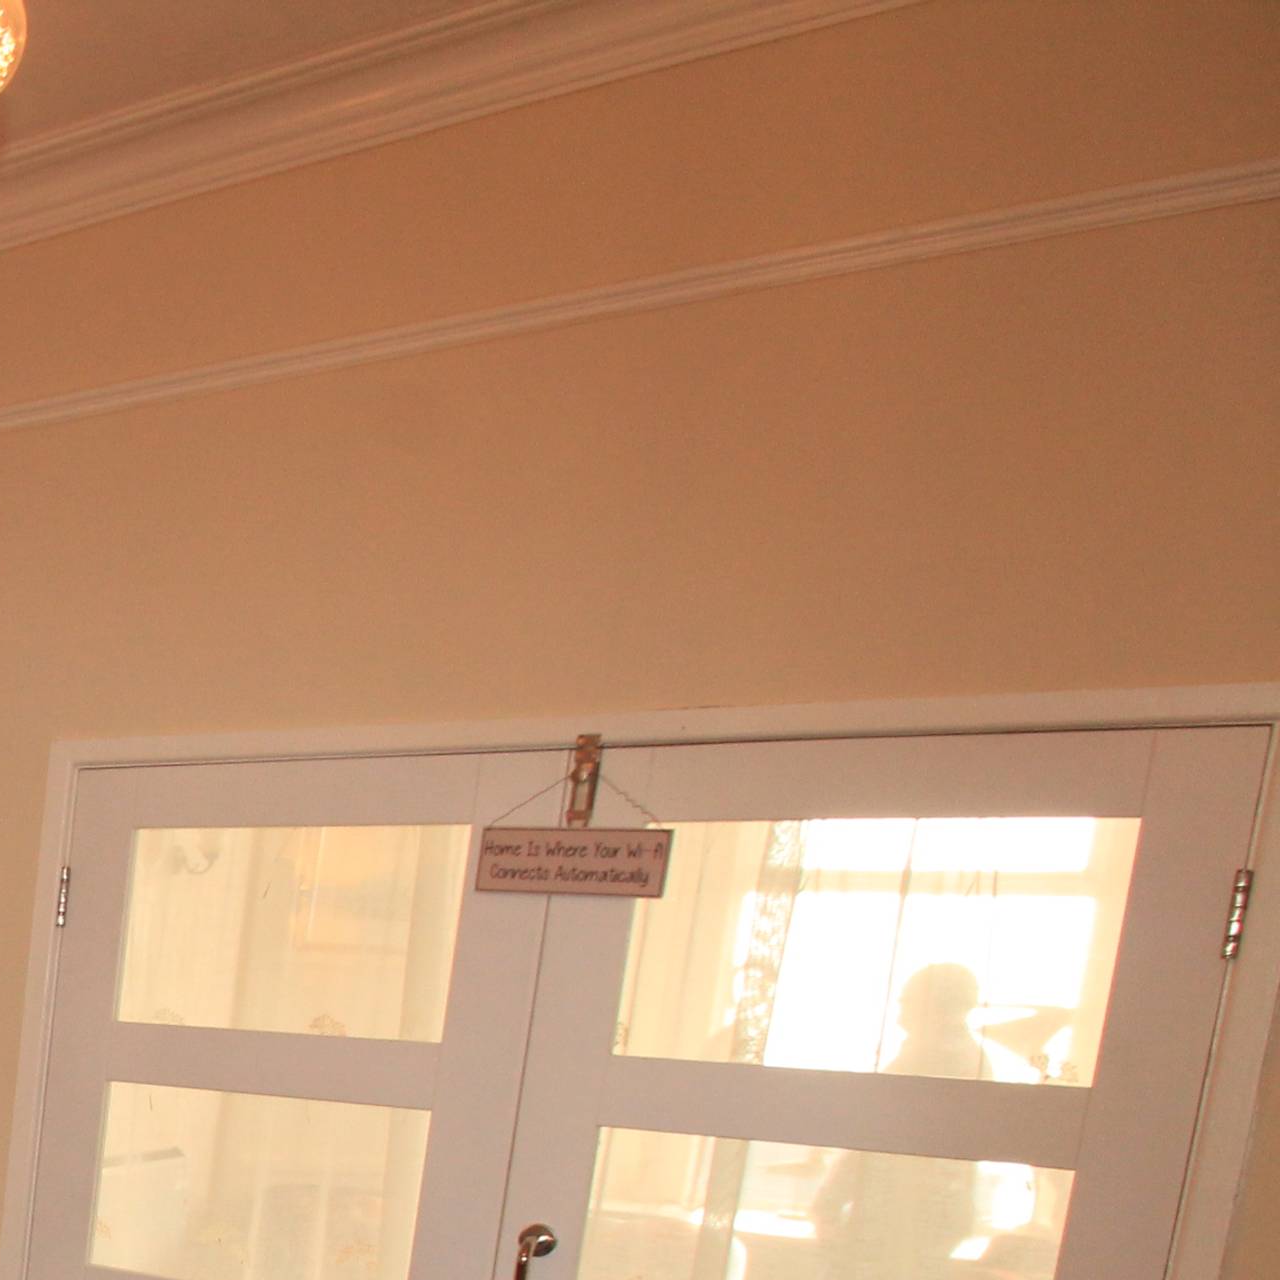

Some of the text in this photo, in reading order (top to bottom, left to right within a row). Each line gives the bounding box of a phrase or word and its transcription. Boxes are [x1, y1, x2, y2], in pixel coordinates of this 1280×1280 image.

[484, 840, 521, 858] Home
[526, 841, 539, 857] Is
[546, 841, 588, 858] Where
[593, 841, 622, 859] Your
[490, 863, 649, 887] Connects Automatically
